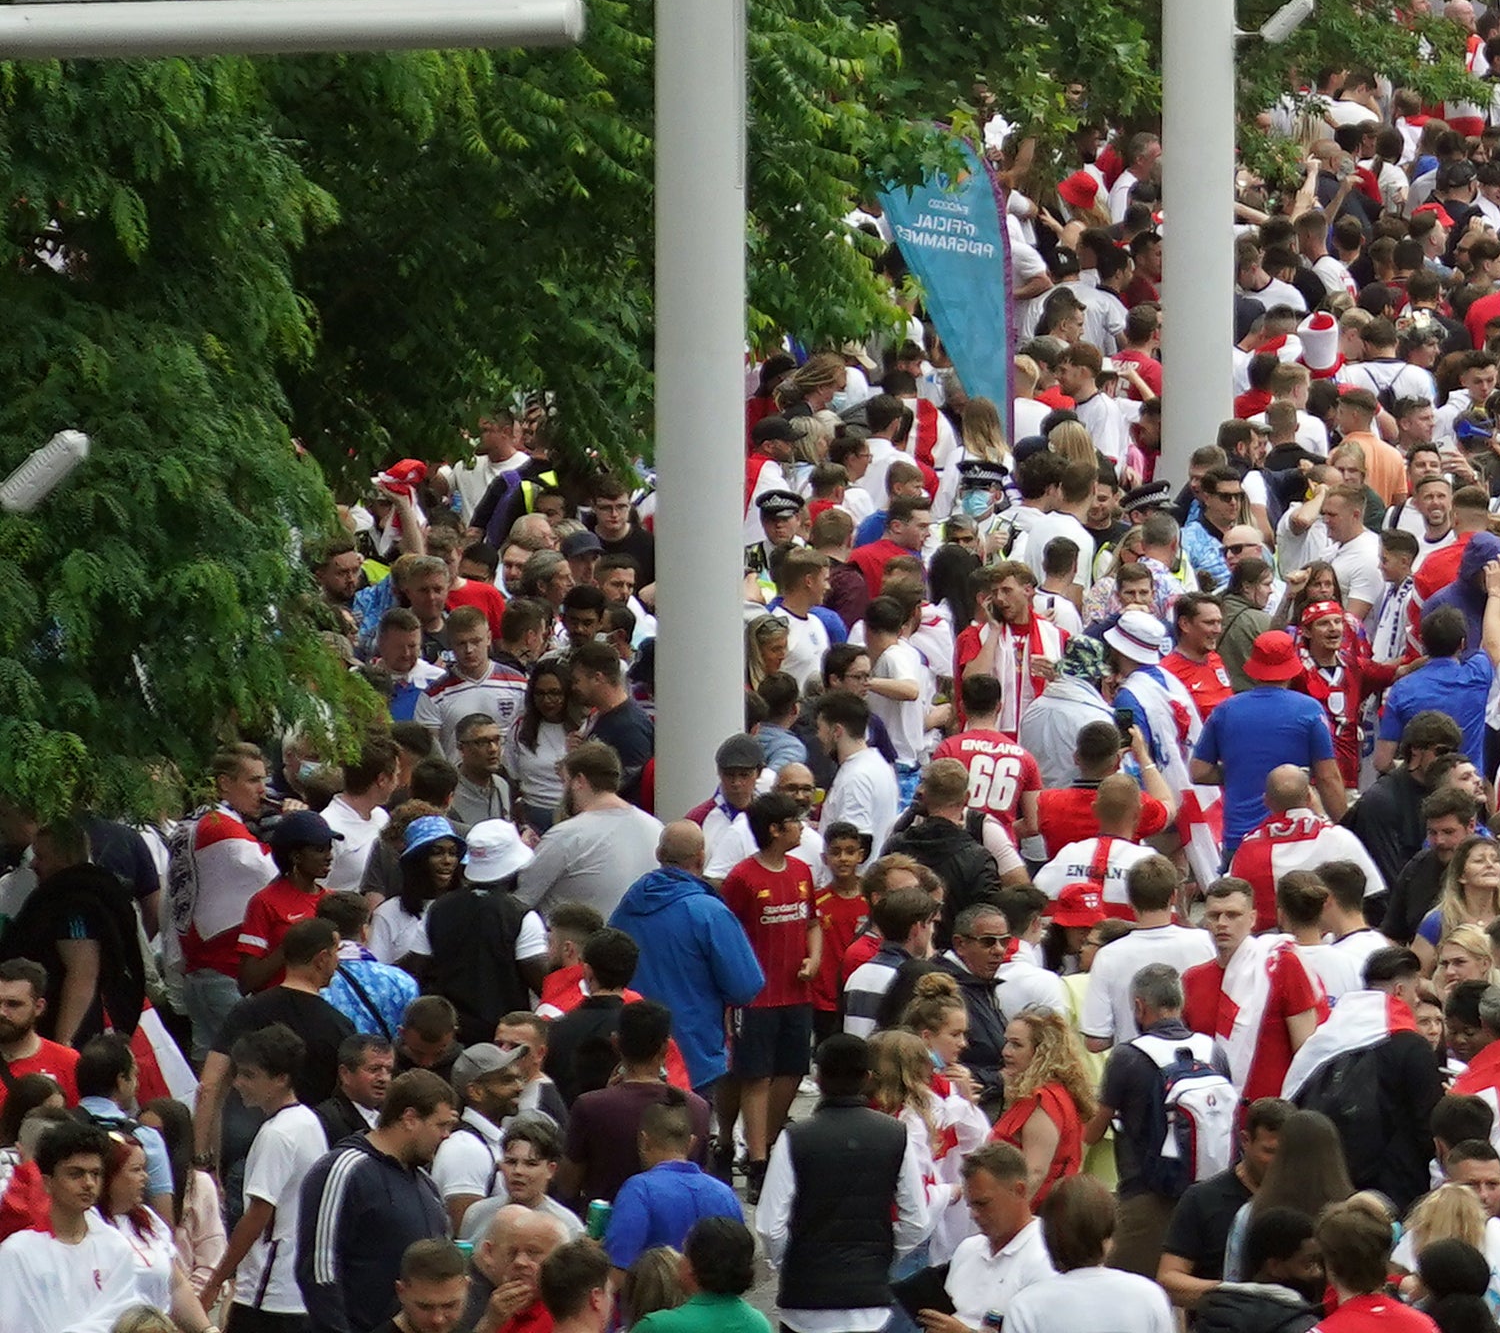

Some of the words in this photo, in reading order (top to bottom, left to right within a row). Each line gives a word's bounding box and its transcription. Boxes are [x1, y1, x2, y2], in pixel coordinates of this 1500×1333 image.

[961, 738, 1025, 757] ENGLAND
[968, 755, 1021, 811] 66
[763, 901, 800, 914] Standard
[759, 911, 801, 925] Chartered
